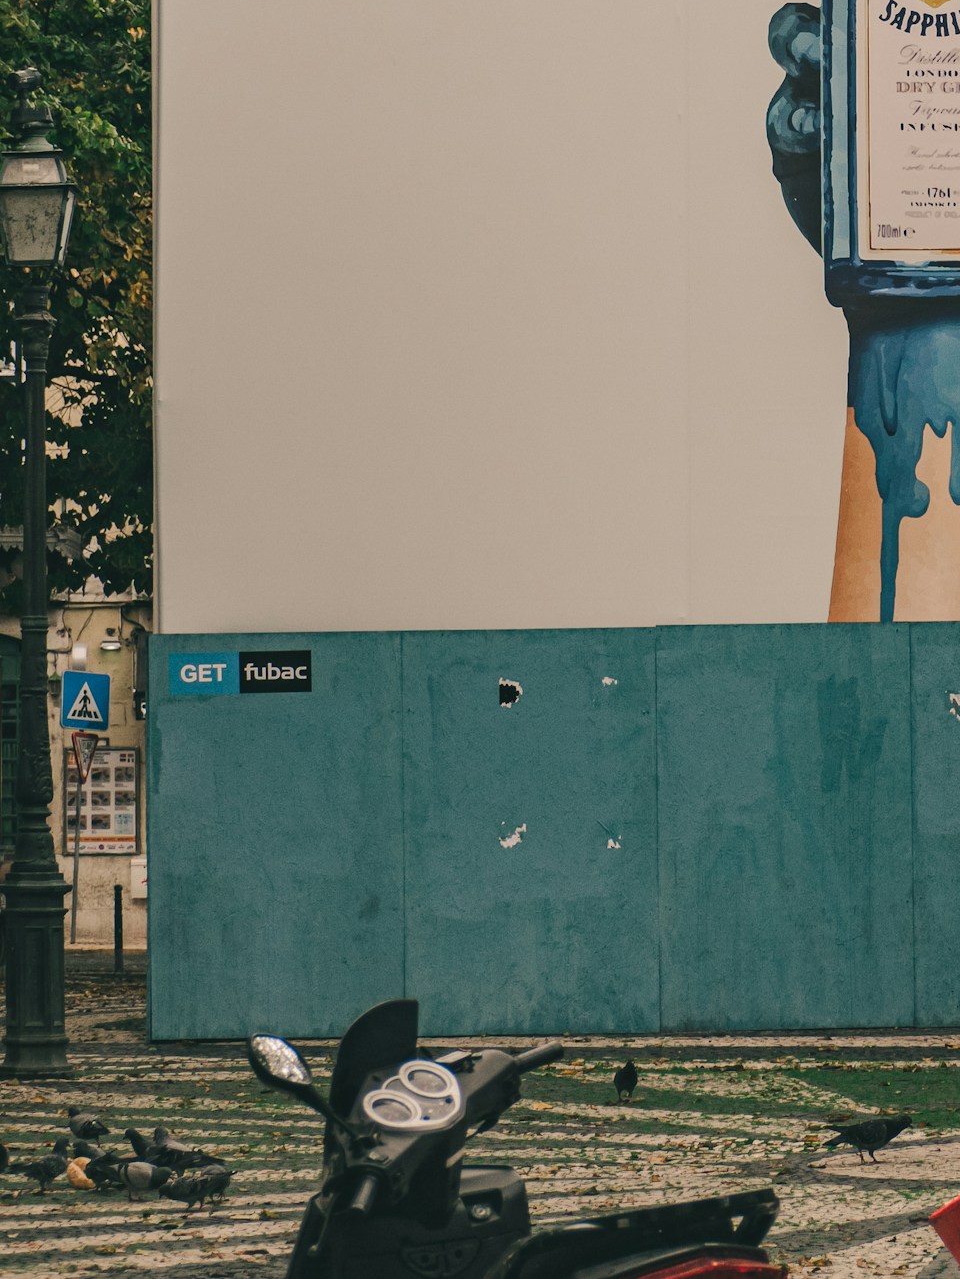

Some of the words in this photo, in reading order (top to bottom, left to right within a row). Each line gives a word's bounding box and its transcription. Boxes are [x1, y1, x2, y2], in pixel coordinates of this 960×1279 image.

[896, 81, 936, 93] DRY
[180, 663, 227, 684] GET
[244, 662, 308, 681] fubac
